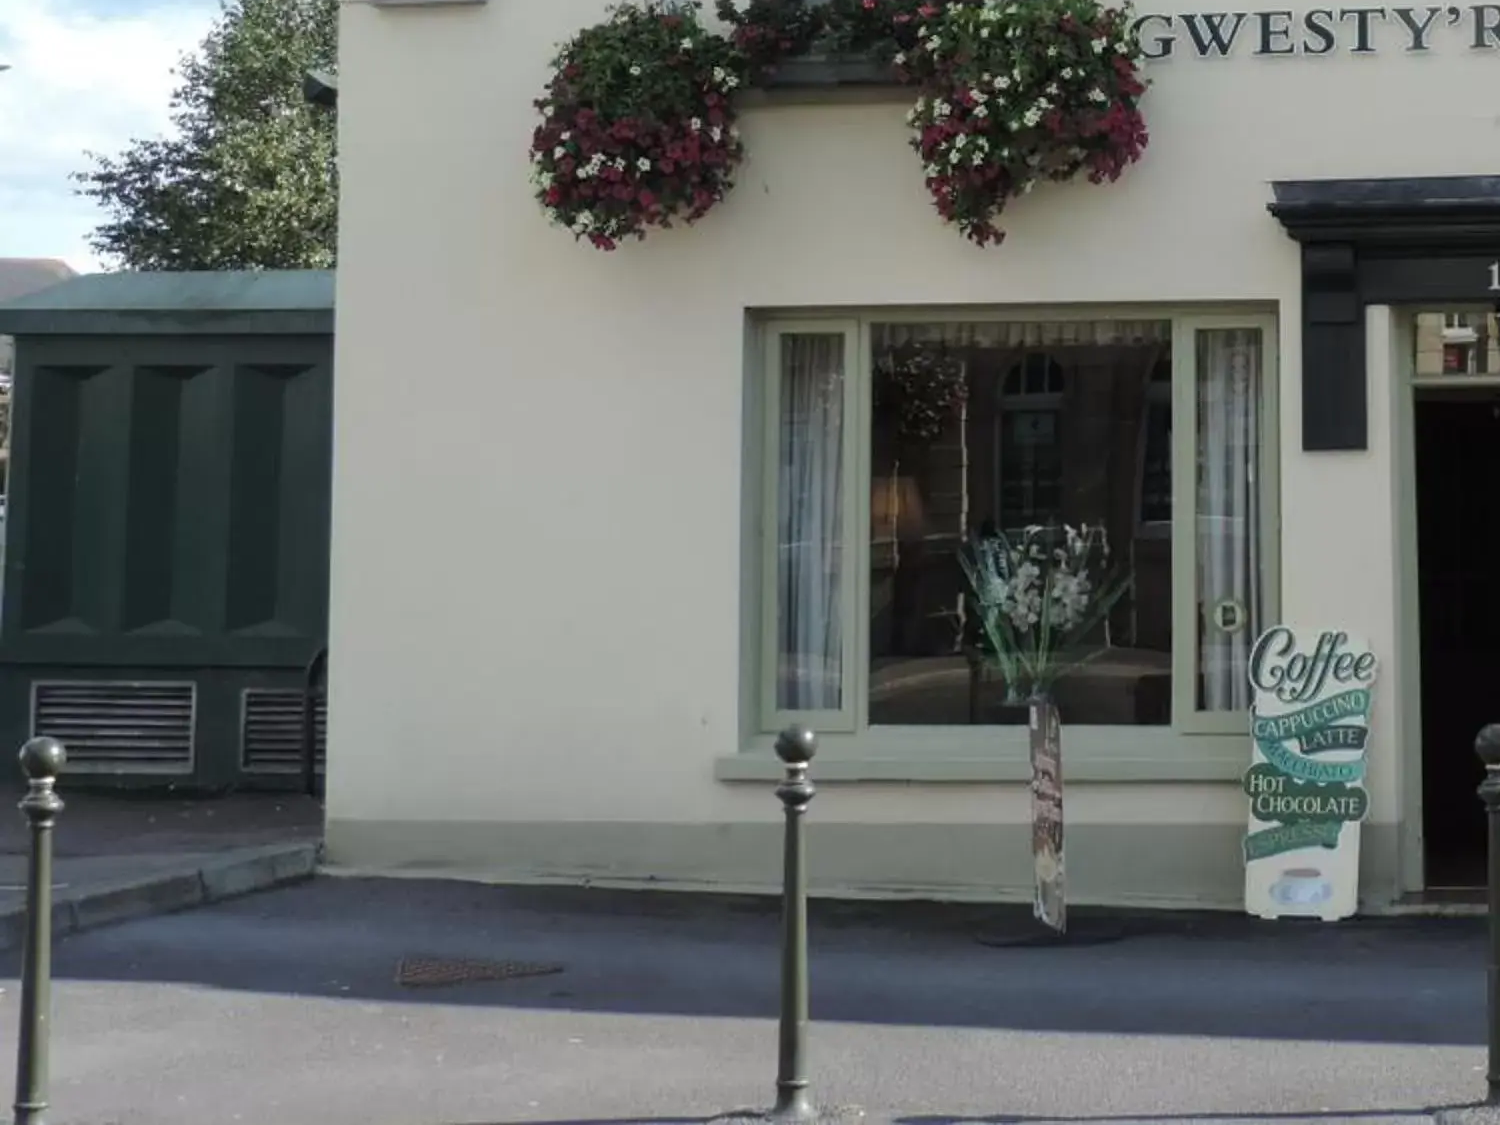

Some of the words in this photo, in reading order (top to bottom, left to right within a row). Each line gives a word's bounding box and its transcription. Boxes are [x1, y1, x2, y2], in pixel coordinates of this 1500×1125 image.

[1251, 627, 1376, 702] Coffee
[1254, 691, 1366, 739] CAPPUCCINO
[1302, 727, 1360, 751] LATTE
[1250, 774, 1287, 794] HOT
[1257, 793, 1360, 815] CHOCOLATE
